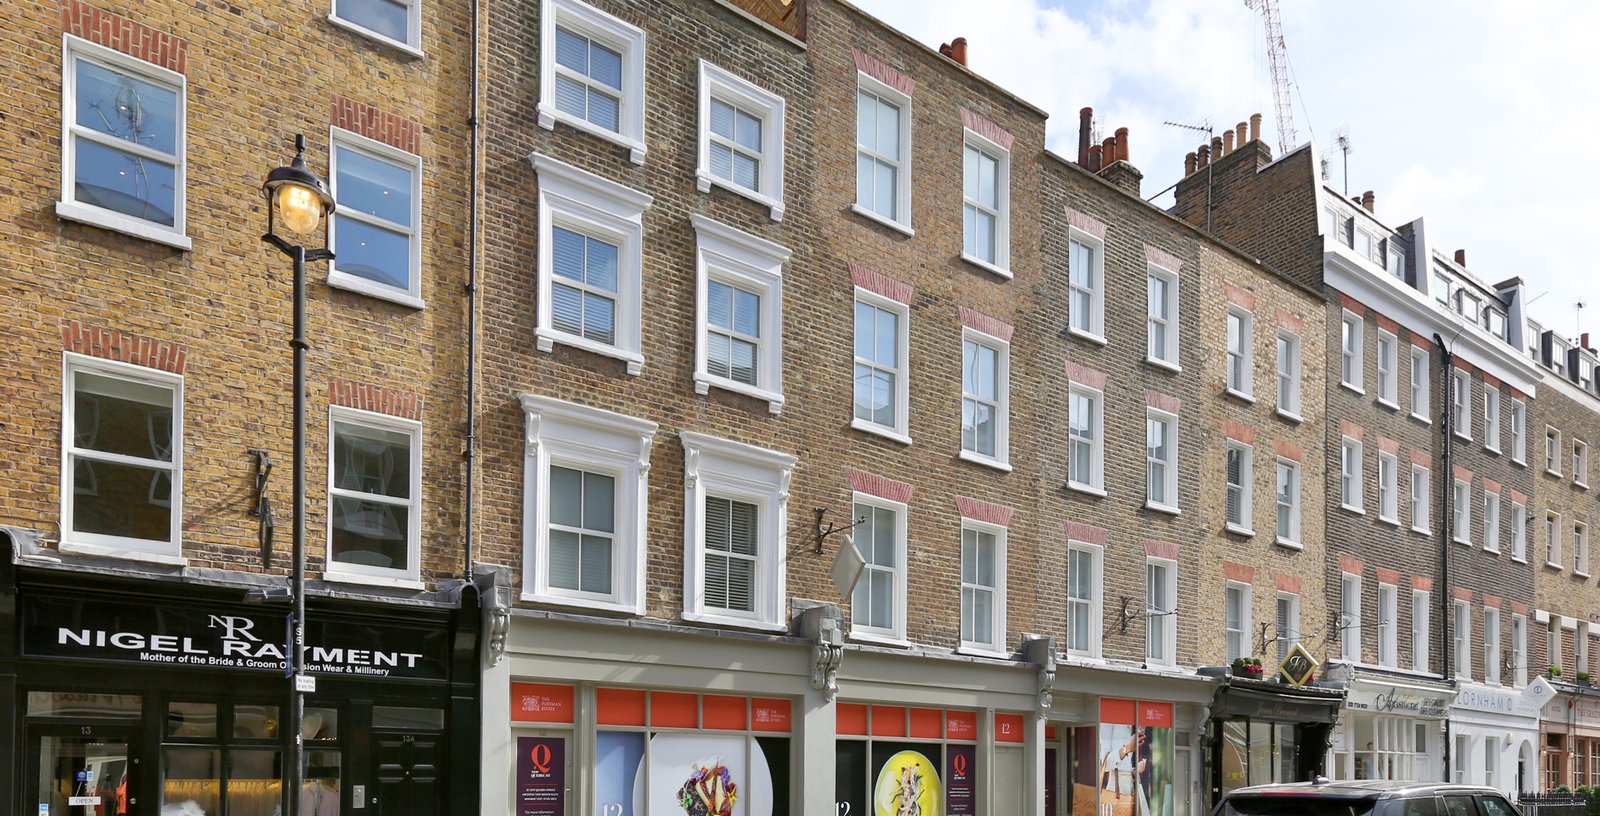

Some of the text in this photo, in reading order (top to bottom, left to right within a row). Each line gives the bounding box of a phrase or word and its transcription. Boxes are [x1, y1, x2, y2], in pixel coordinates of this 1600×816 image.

[58, 627, 423, 668] NIGEL RAMENT
[140, 652, 176, 663] Mother
[178, 655, 188, 663] of
[190, 656, 206, 664] the
[208, 657, 234, 666] Bride
[246, 660, 277, 669] Groom
[322, 663, 343, 672] Wear
[354, 665, 390, 677] Millinery
[81, 726, 92, 735] 13
[1001, 723, 1011, 734] 12
[531, 744, 552, 774] Q
[953, 754, 967, 777] Q
